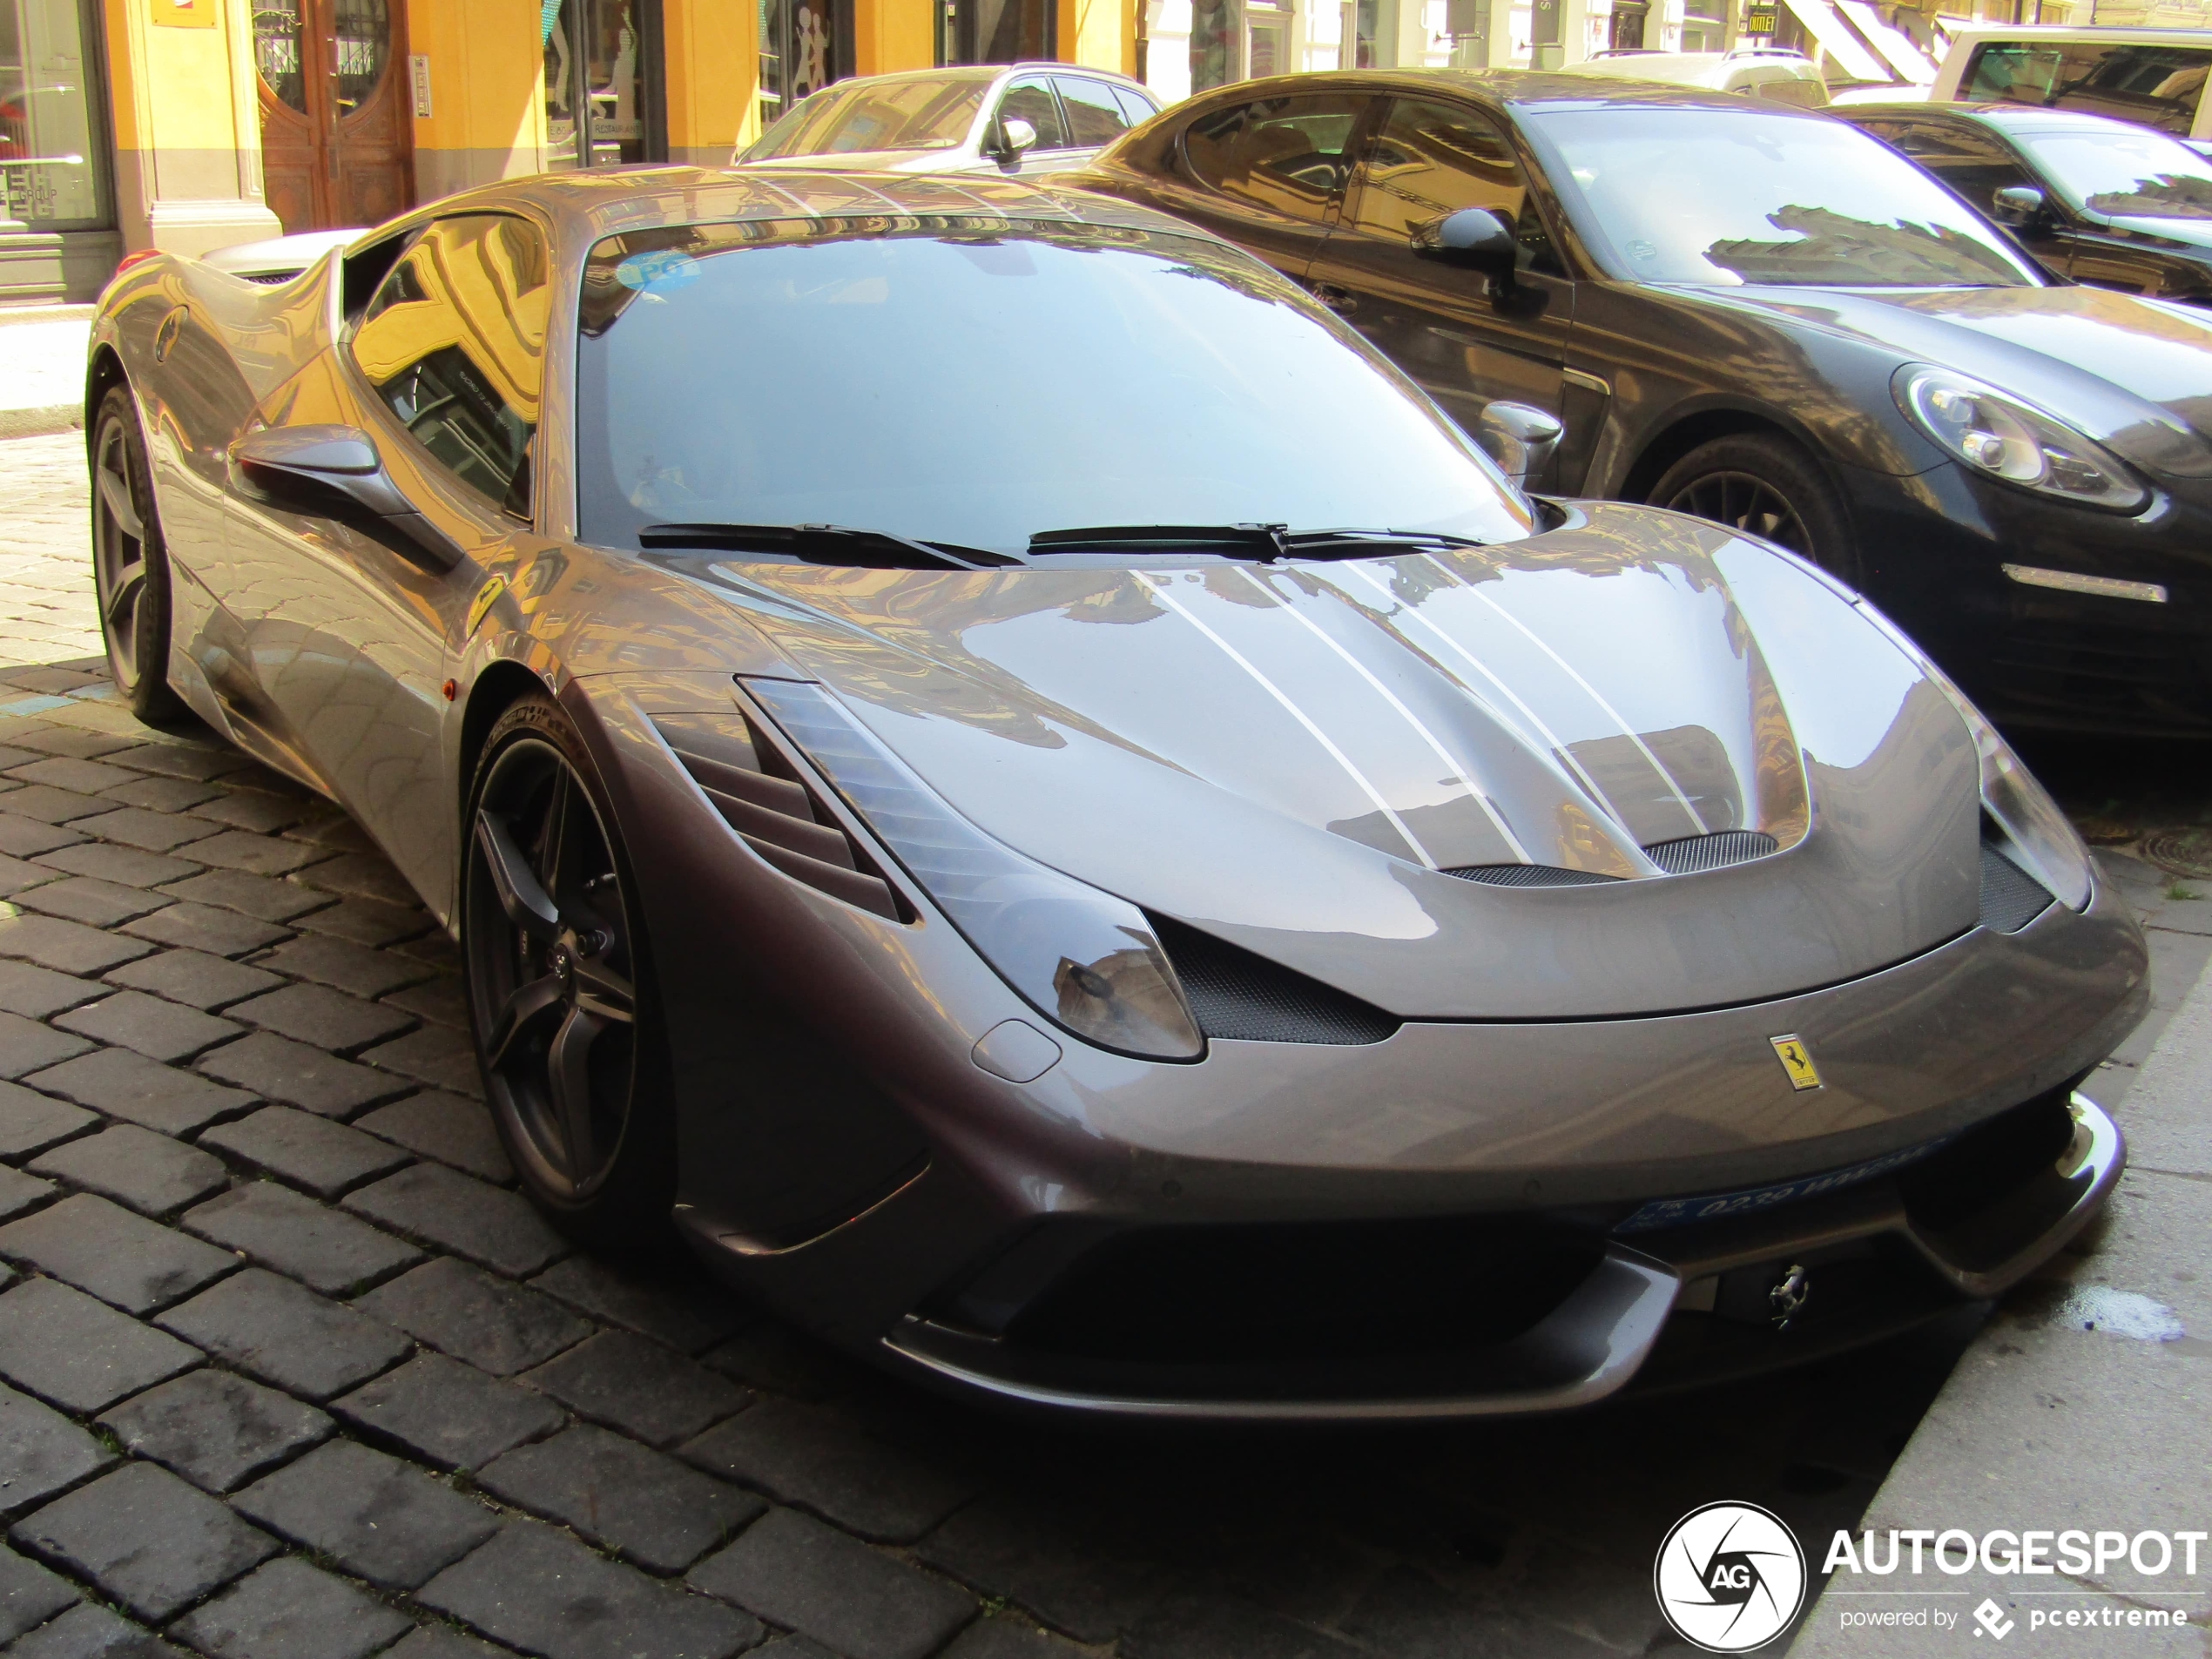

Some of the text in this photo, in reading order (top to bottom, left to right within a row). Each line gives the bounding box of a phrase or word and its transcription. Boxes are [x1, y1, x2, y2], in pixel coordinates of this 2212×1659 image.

[1749, 16, 1776, 32] OUTLET
[595, 125, 640, 135] RESTAURANT
[20, 189, 57, 200] GROUP
